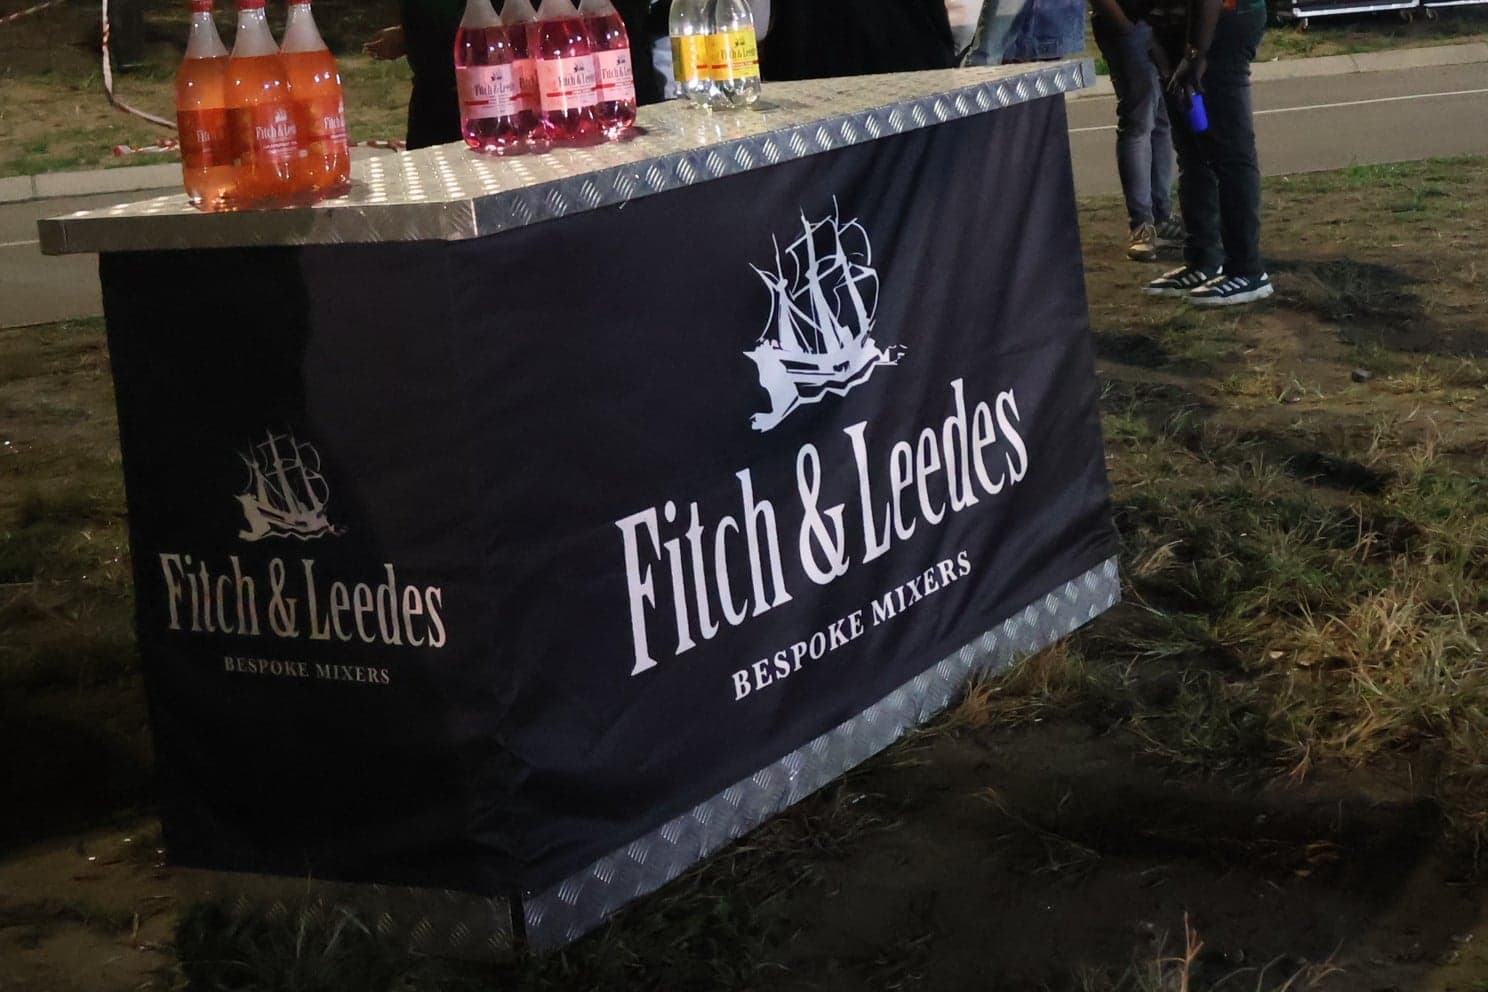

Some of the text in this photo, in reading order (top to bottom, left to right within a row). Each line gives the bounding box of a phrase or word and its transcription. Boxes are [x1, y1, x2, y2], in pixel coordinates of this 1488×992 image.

[615, 378, 1028, 676] Fitch & Leedes
[159, 553, 447, 648] Fitch & Leedes
[731, 550, 972, 701] BESPOKE MIXERS
[224, 657, 390, 685] BESPOKE MIXERS
